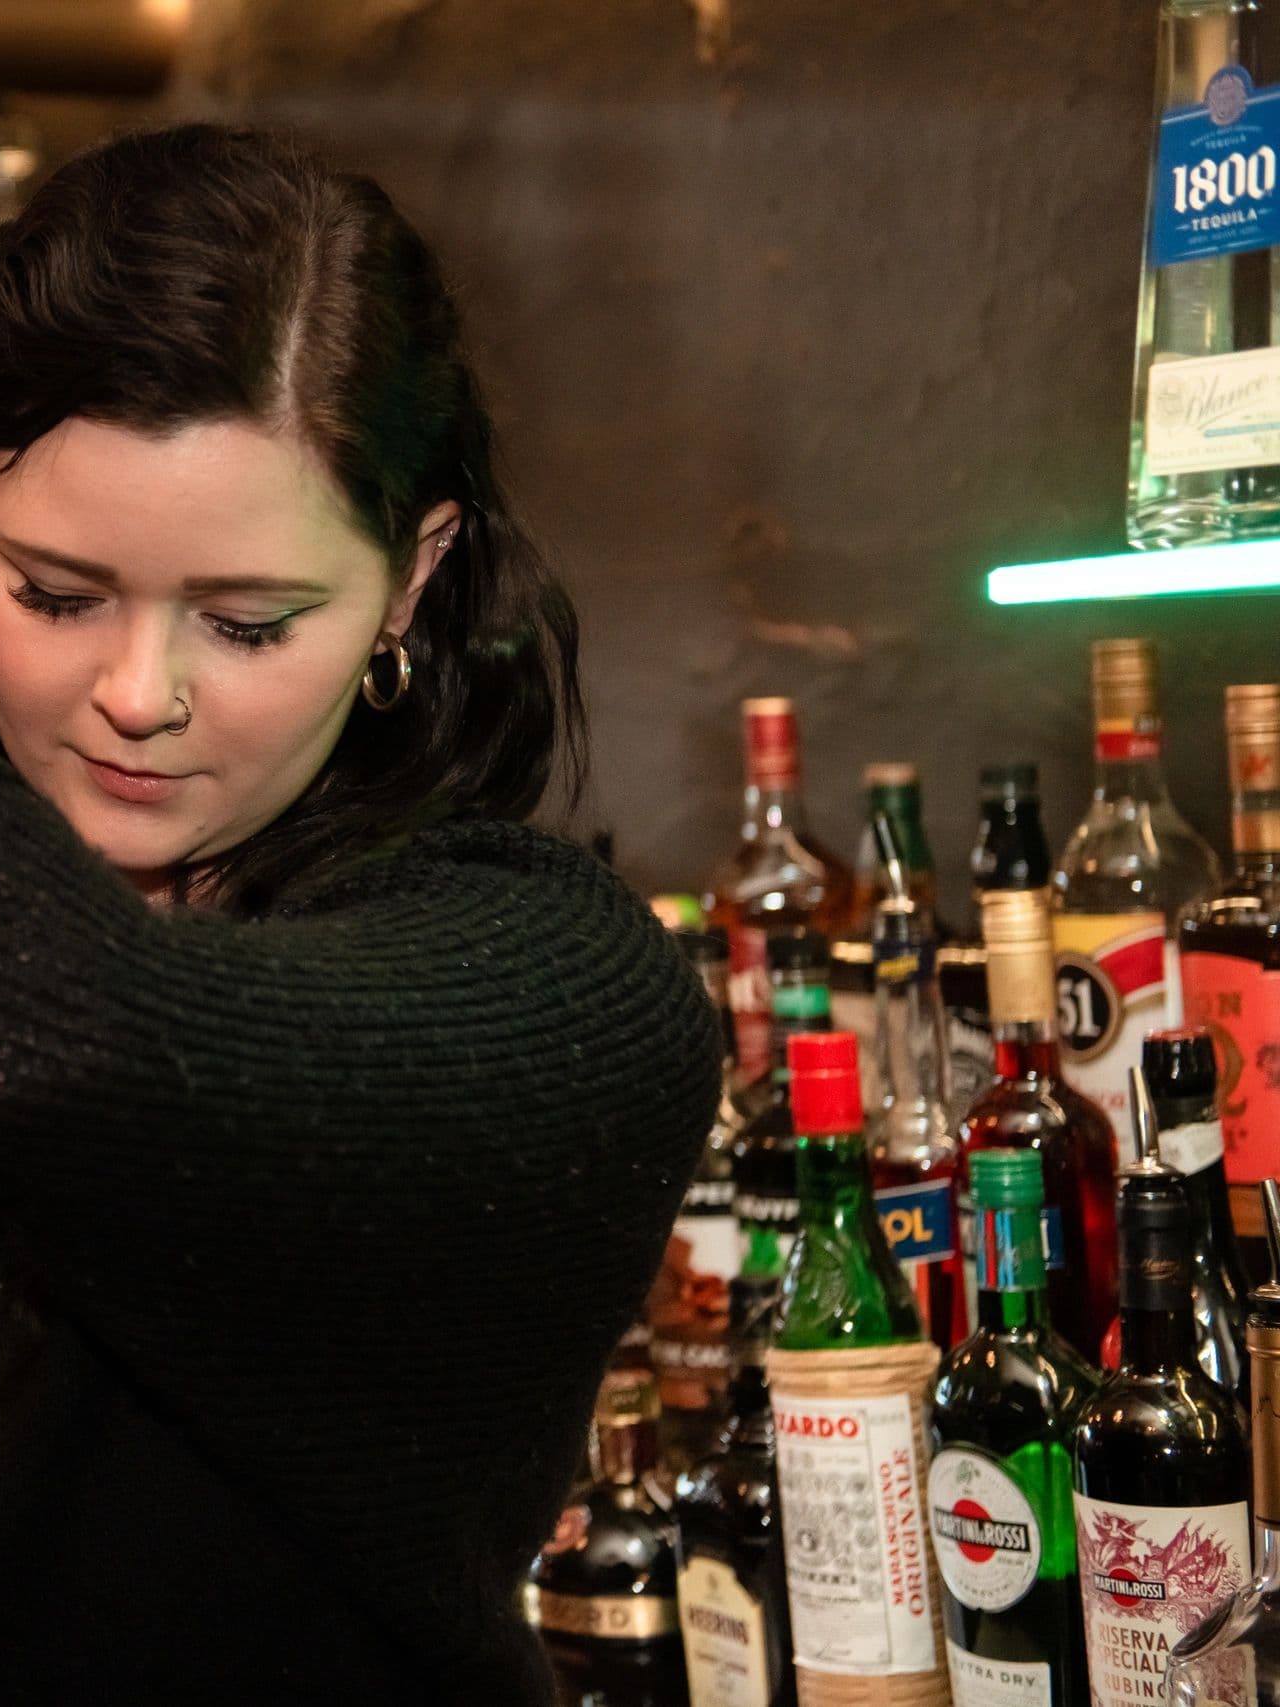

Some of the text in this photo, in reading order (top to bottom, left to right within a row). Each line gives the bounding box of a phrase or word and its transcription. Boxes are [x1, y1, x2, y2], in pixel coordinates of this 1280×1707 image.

[1172, 144, 1277, 214] 1800
[1191, 207, 1258, 231] TEQUILA
[1058, 977, 1102, 1037] 51
[880, 1205, 934, 1250] OL
[878, 1461, 904, 1606] MARASCHINO
[891, 1448, 925, 1617] ORIGINALE
[1096, 1643, 1171, 1674] SPECIAL
[1098, 1623, 1170, 1652] RISERVA
[1000, 1670, 1036, 1687] DRY
